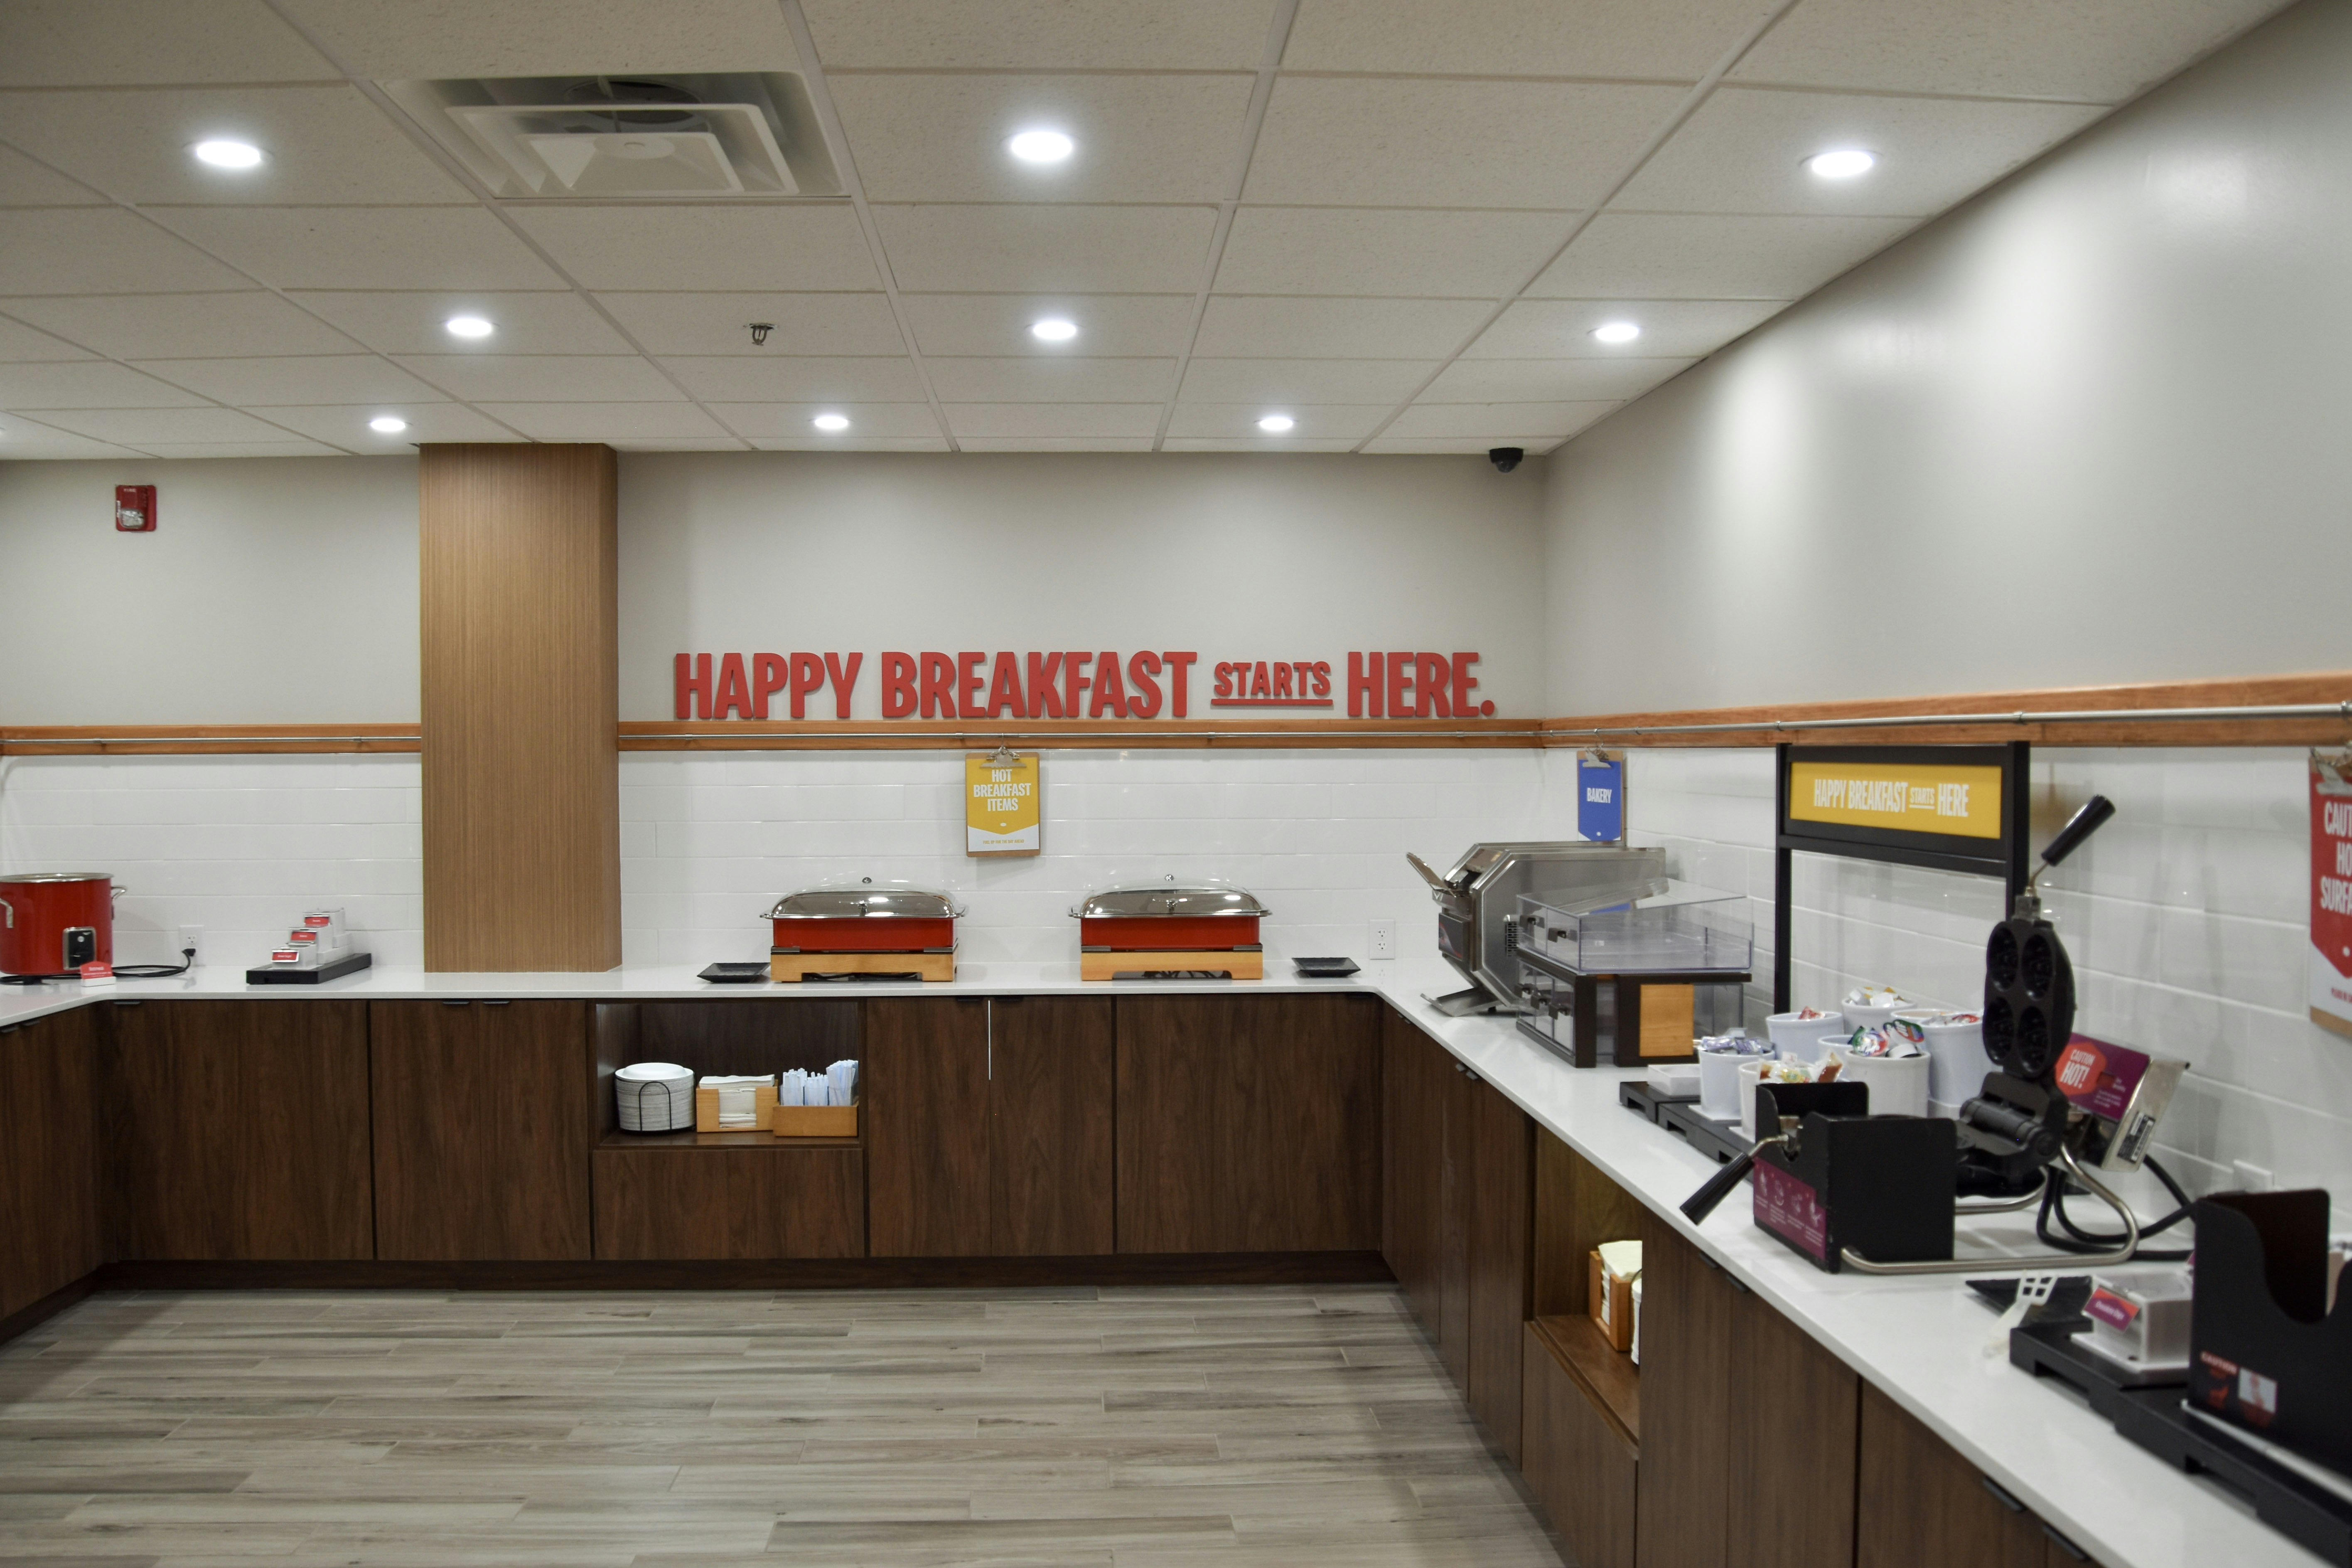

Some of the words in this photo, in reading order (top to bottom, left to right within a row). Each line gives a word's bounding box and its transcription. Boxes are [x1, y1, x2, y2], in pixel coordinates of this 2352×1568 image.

[676, 652, 863, 719] HAPPY
[882, 650, 1197, 718] BREAKFAST
[1214, 661, 1330, 696] STARTS
[1348, 651, 1494, 718] HERE.
[992, 769, 1013, 782] HOT
[973, 783, 1031, 797] BREAKFAST
[1587, 787, 1612, 804] BAKERY
[1814, 779, 1848, 809] HAPPY
[1848, 780, 1908, 813] BREAKFAST
[1910, 787, 1935, 804] STARTS
[1937, 783, 1969, 817] HERE
[987, 798, 1018, 811] ITEMS
[2070, 1049, 2095, 1065] CAUTION
[2060, 1061, 2090, 1089] HOT!
